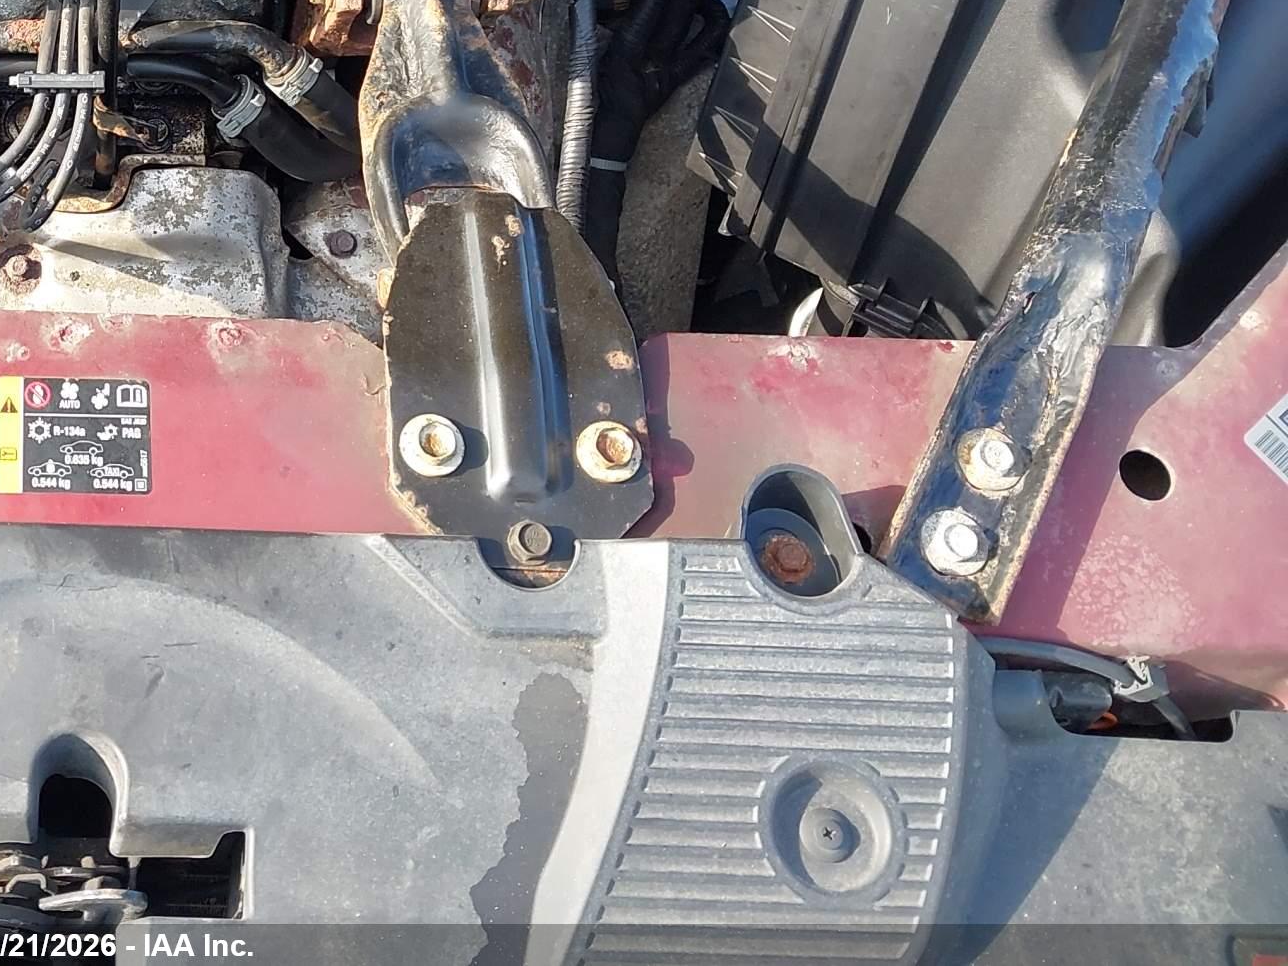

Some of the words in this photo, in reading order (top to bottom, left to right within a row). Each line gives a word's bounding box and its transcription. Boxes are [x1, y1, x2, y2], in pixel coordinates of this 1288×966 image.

[59, 400, 80, 409] AUTO
[53, 426, 86, 437] R-134a
[122, 427, 141, 438] PAG
[92, 455, 103, 466] kg
[105, 467, 120, 476] TAXI
[32, 478, 56, 488] 0.544
[59, 478, 71, 490] kg
[93, 479, 119, 489] 0.544
[120, 479, 132, 491] kg
